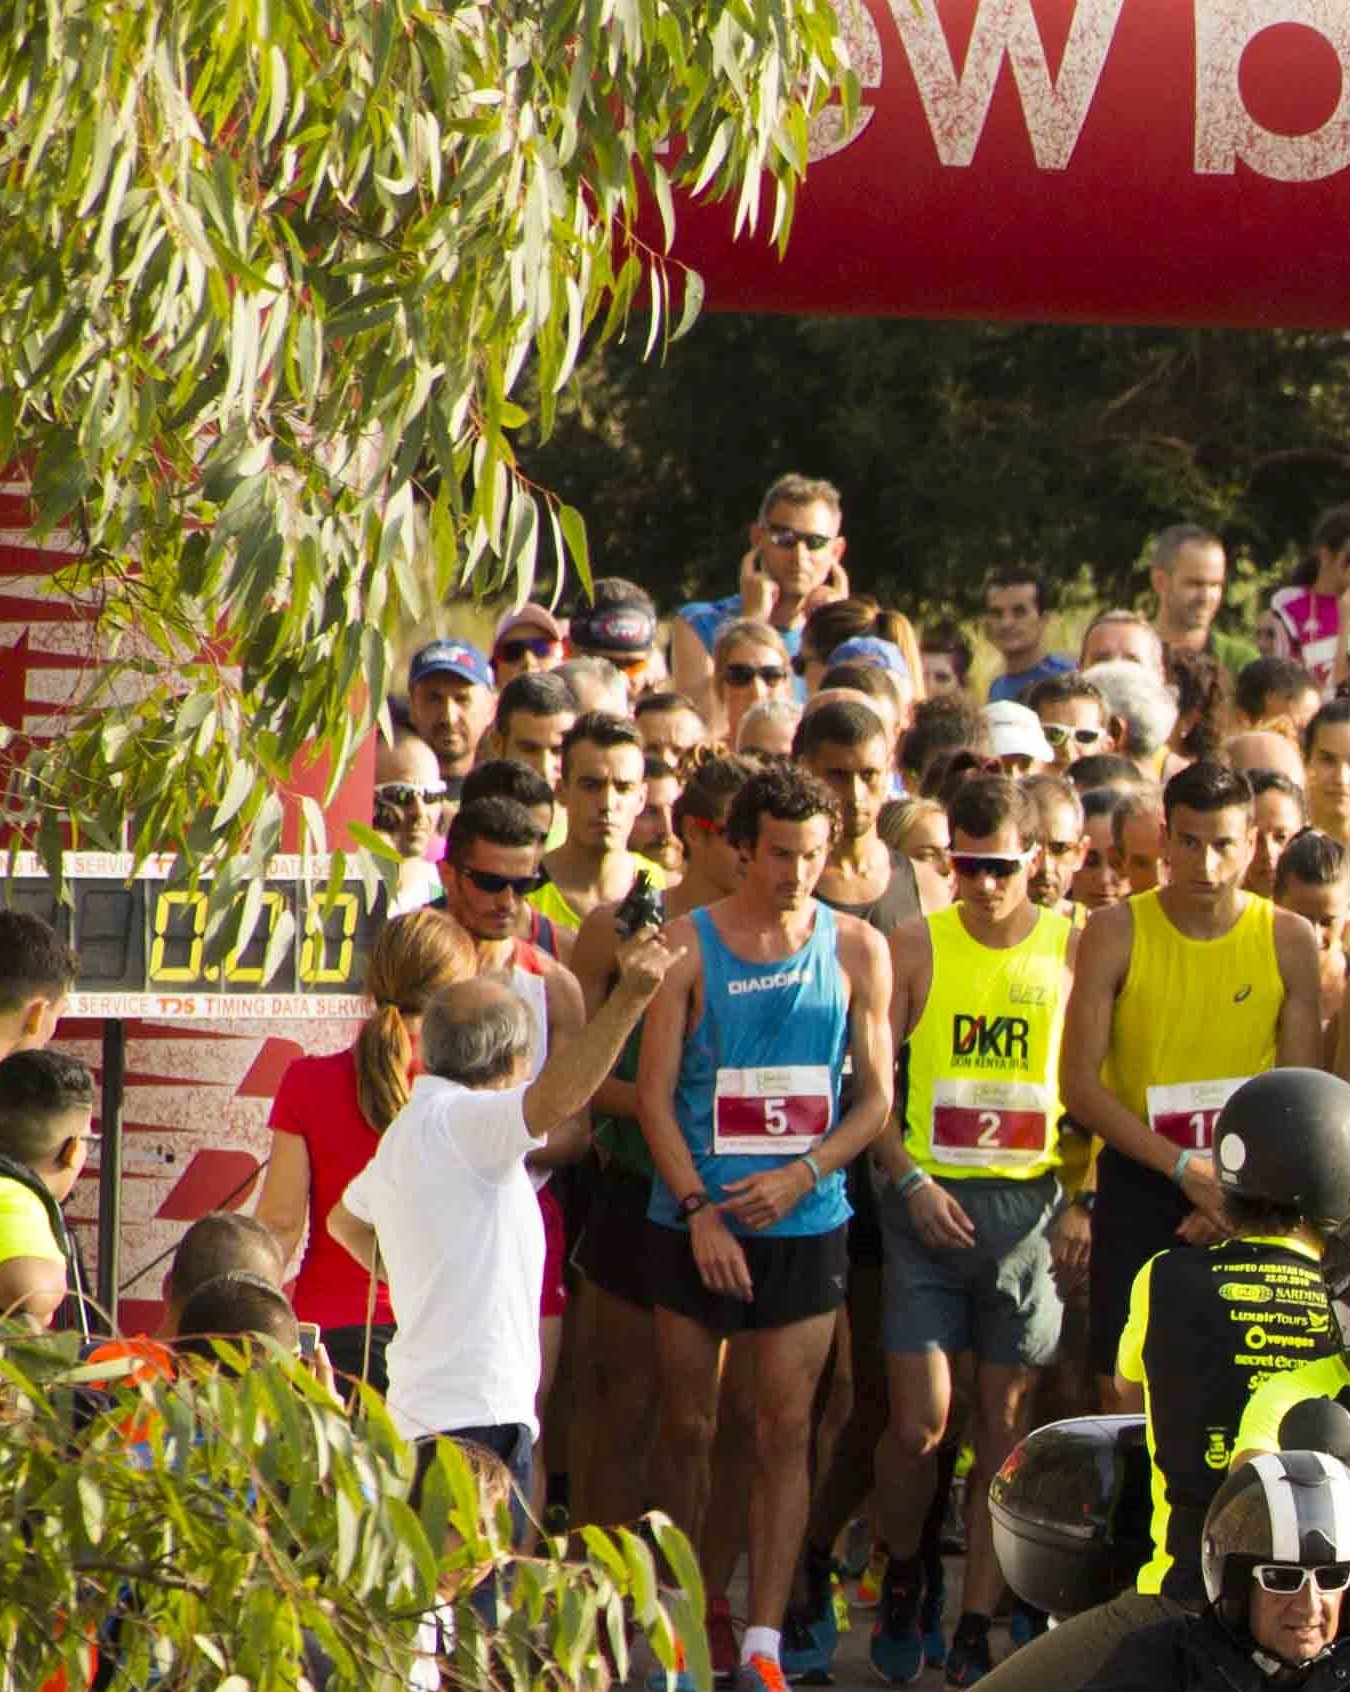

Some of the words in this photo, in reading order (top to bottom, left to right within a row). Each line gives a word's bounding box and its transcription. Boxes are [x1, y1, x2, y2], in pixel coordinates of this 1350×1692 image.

[204, 998, 265, 1015] TIMING
[271, 998, 312, 1015] DATA
[953, 1014, 1029, 1058] DKR
[763, 1097, 790, 1136] 5
[978, 1111, 1001, 1148] 2
